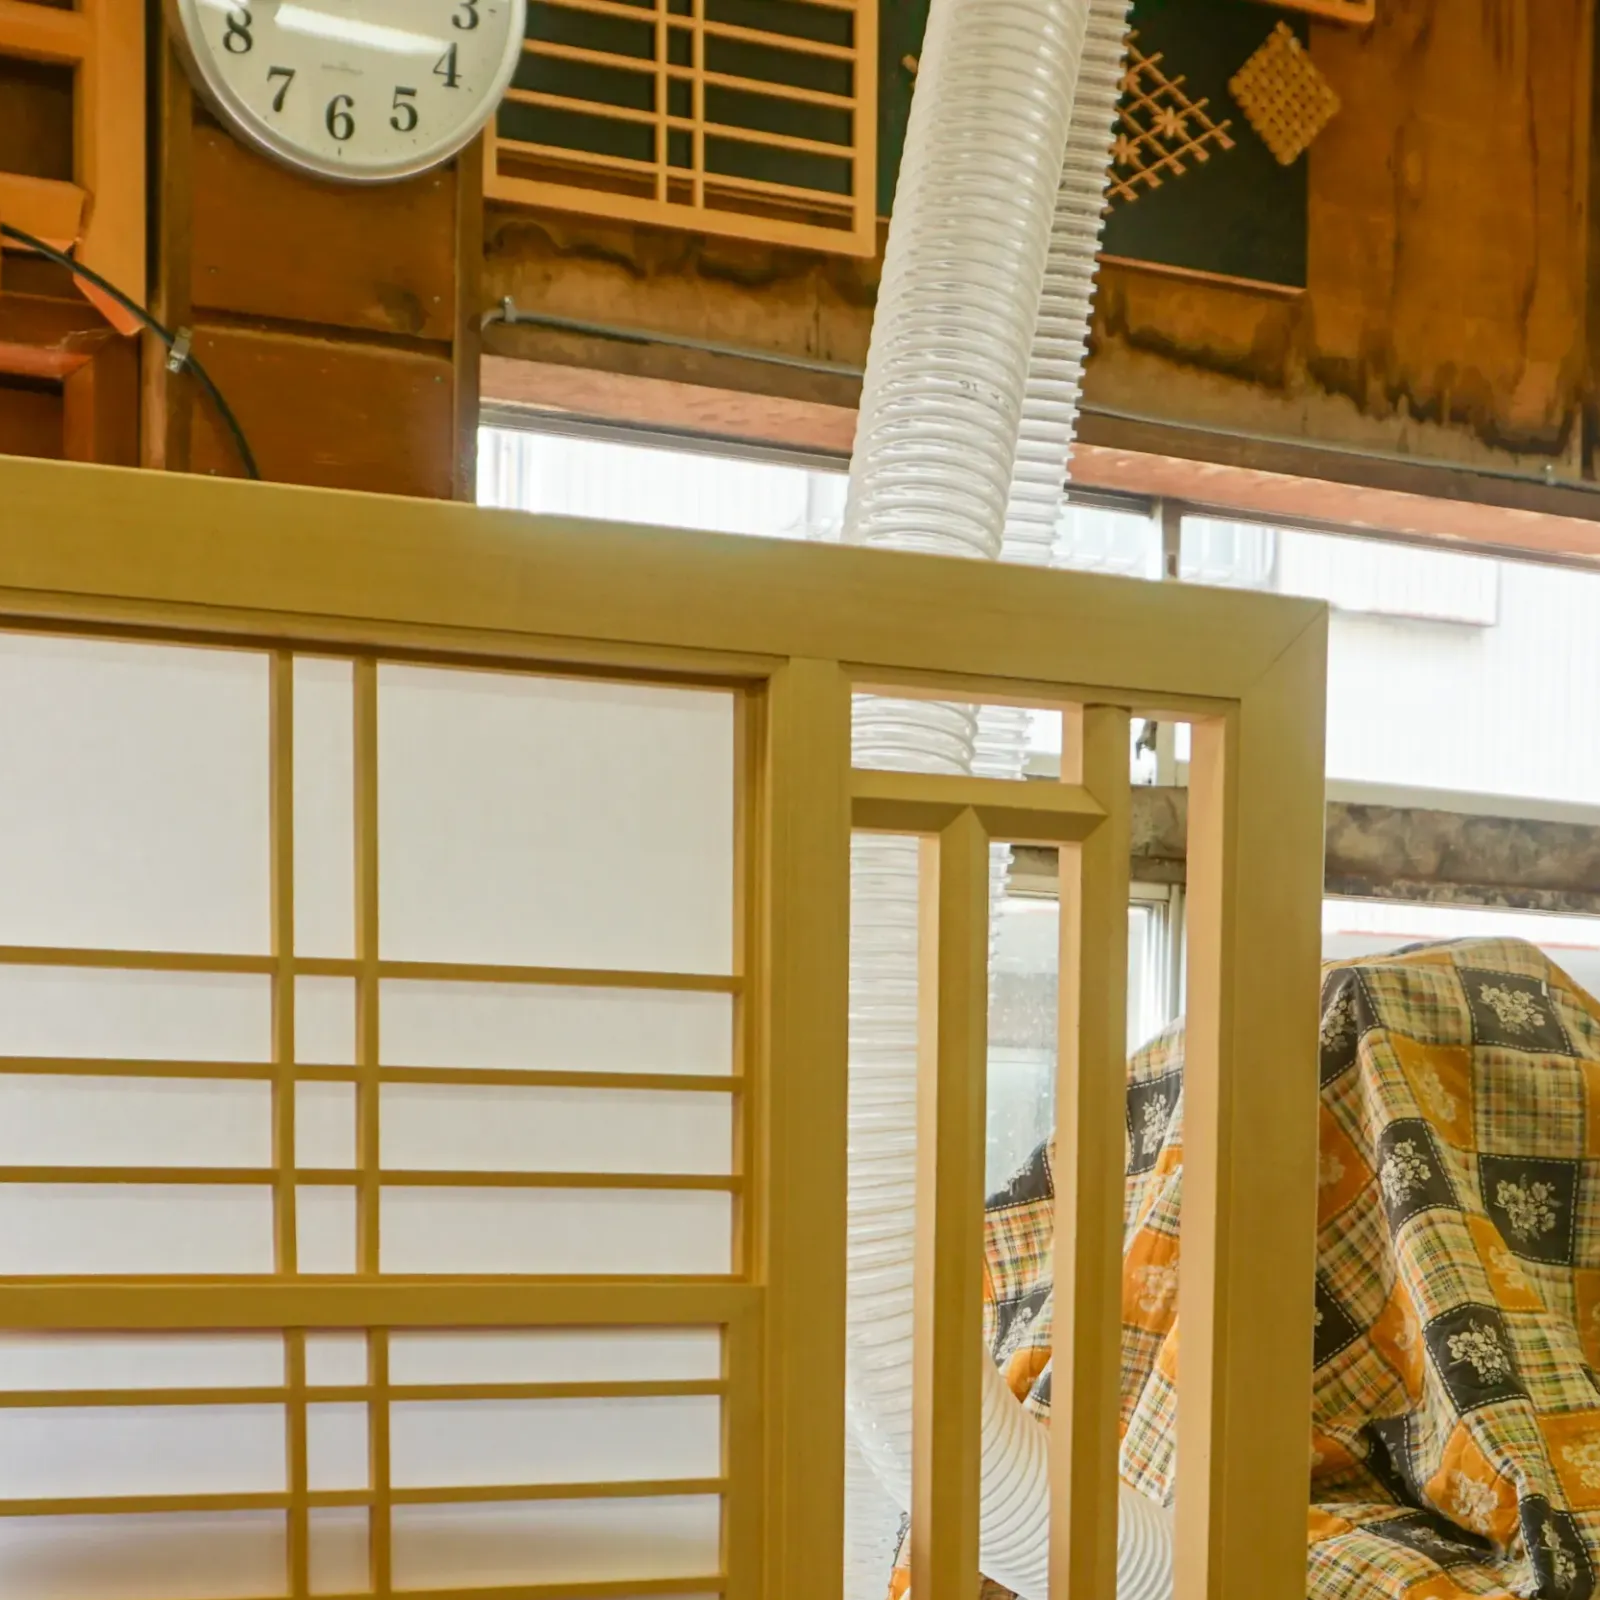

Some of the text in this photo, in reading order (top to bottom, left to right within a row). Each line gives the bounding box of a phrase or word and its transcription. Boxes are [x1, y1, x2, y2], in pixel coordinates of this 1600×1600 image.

[223, 7, 253, 54] 8
[451, 0, 479, 31] 3
[433, 42, 462, 89] 4
[267, 66, 296, 112] 7
[390, 86, 419, 132] 5
[326, 94, 355, 141] 6
